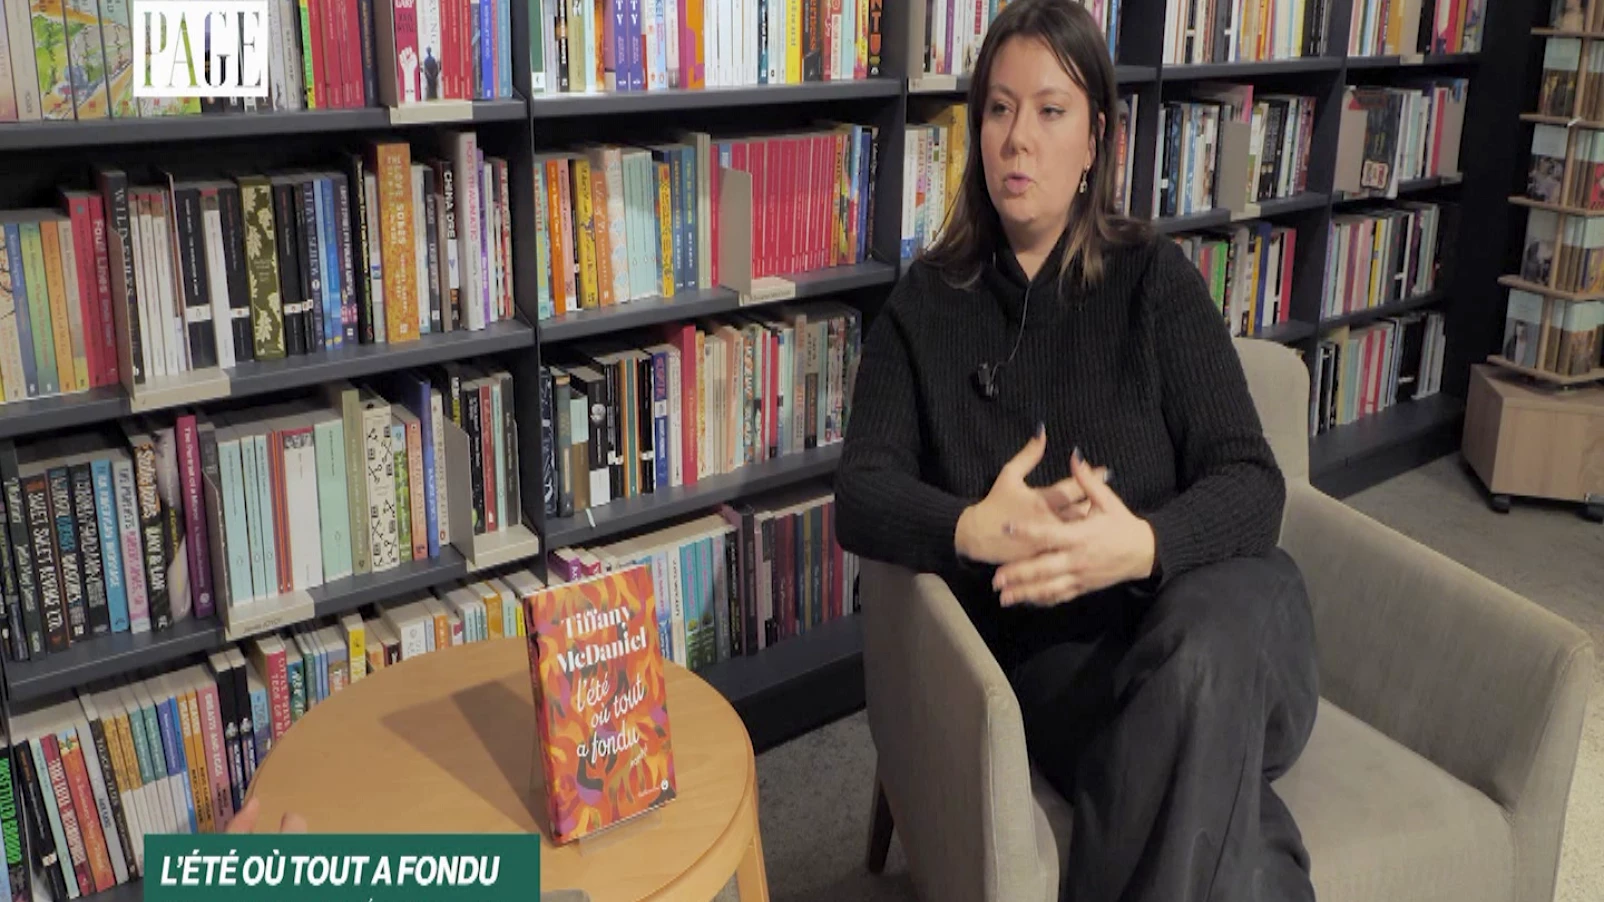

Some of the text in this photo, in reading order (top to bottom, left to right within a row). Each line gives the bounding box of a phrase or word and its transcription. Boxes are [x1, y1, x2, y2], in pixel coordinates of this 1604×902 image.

[394, 164, 403, 197] LOVE
[444, 171, 453, 210] CHINA
[113, 188, 129, 241] WILD
[397, 204, 406, 245] SONGS
[92, 219, 105, 253] Fault
[96, 255, 109, 294] Lines
[182, 426, 192, 442] The
[185, 444, 195, 475] Portrait
[28, 491, 46, 525] SWEET
[34, 526, 52, 564] SWEET
[560, 605, 632, 640] Tiffany
[556, 631, 648, 674] McDaniel
[576, 673, 610, 713] l'été
[590, 678, 646, 729] où tout
[204, 692, 222, 777] BREASTS AND EGGS
[576, 727, 641, 765] a fondu
